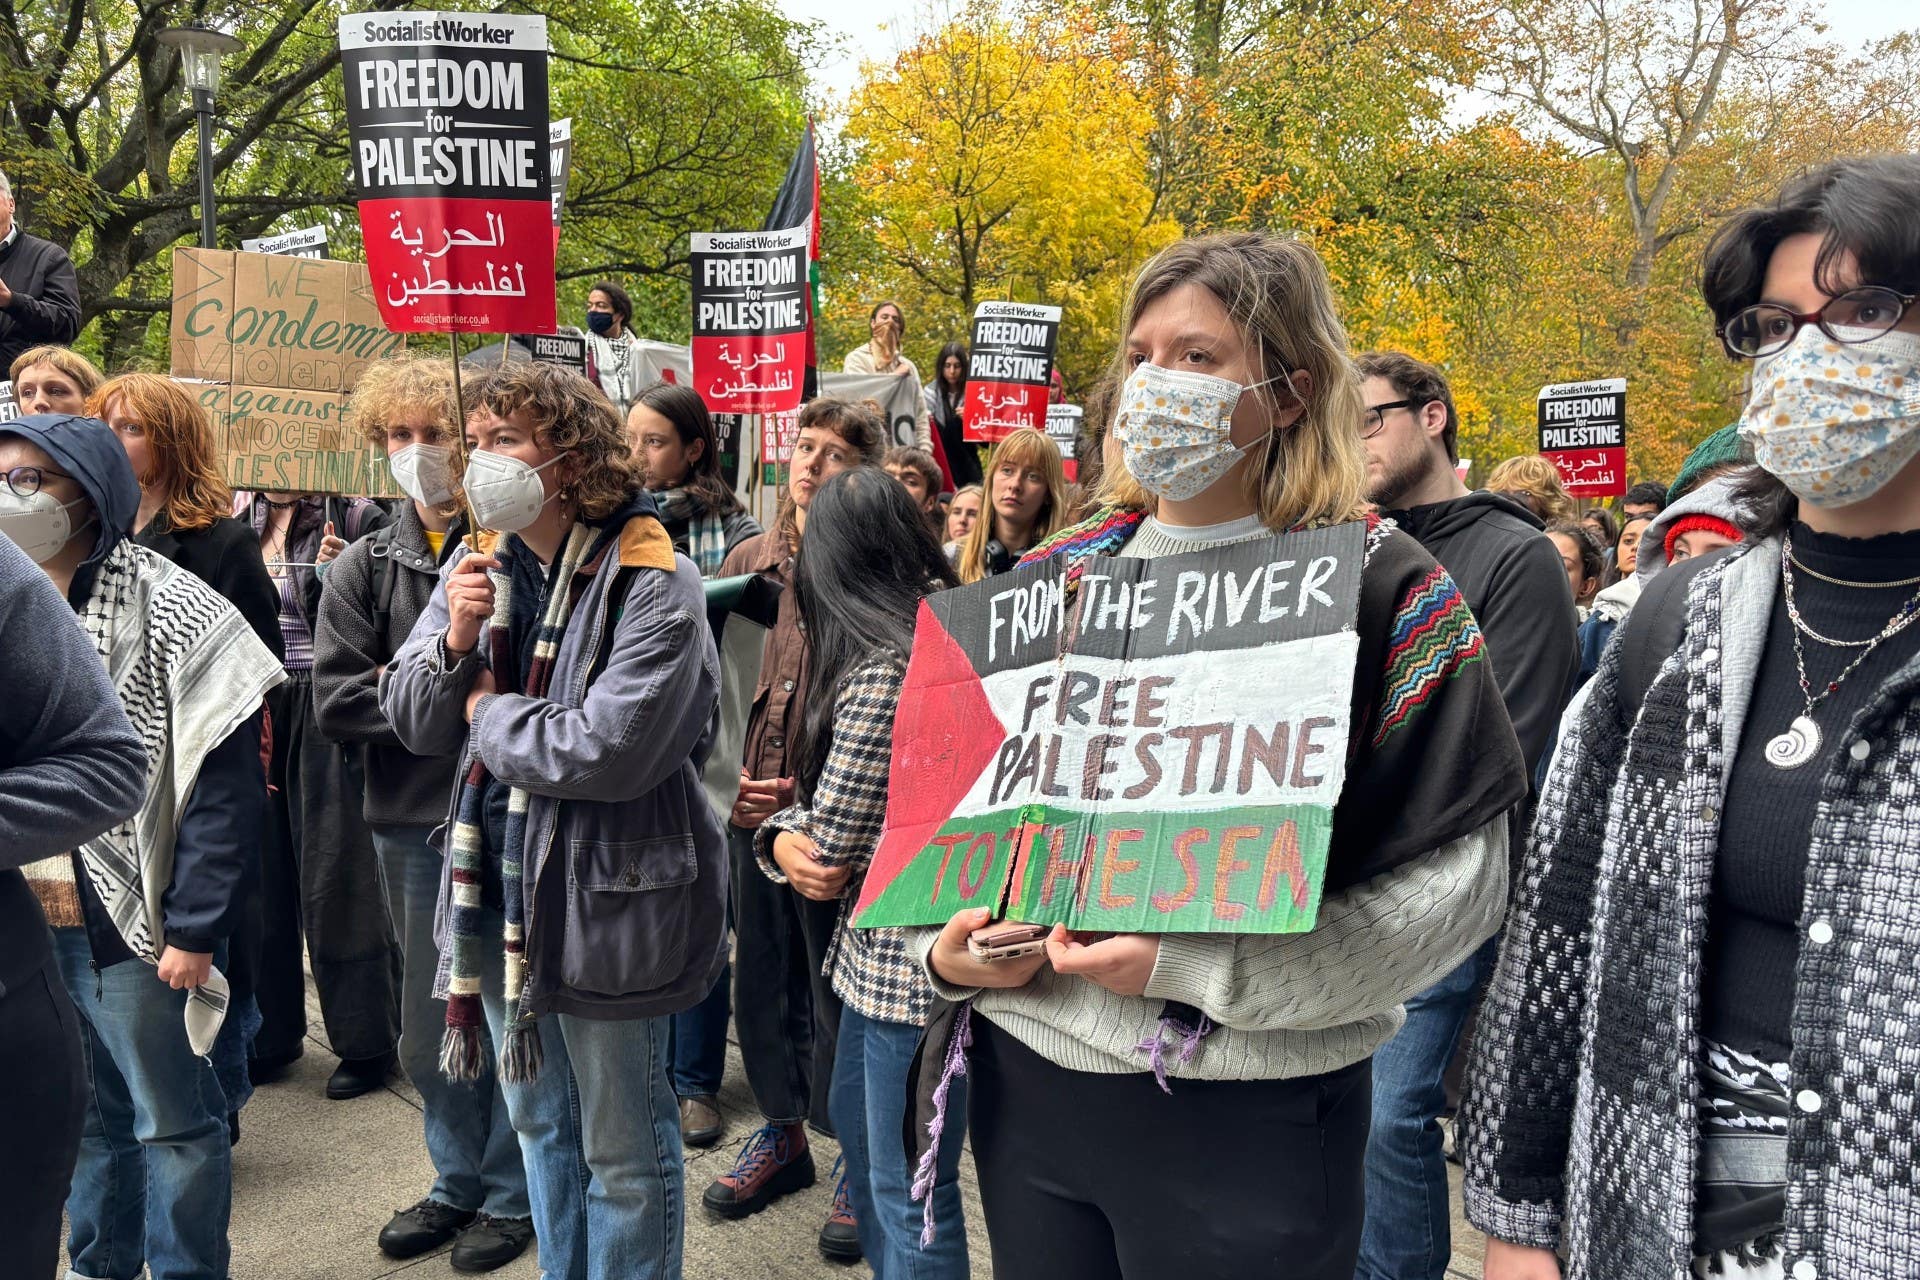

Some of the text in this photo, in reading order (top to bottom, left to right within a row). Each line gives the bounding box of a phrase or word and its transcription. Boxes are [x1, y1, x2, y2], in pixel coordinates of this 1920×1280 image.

[358, 59, 524, 110] FREEDOM
[425, 109, 453, 133] for
[359, 137, 537, 188] PALESTINE
[389, 210, 505, 257] الحرية
[265, 258, 325, 300] WE
[387, 259, 526, 307] لفلسطين
[703, 254, 796, 287] FREEDOM
[745, 286, 762, 300] for
[413, 312, 490, 325] socialistworker.co.uk
[699, 298, 801, 330] PALESTINE
[536, 337, 580, 358] FREEDOM
[976, 321, 1049, 347] FREEDOM
[718, 341, 785, 371] الحرية
[1001, 344, 1015, 356] for
[970, 355, 1048, 381] PALESTINE
[709, 369, 793, 398] لفلسطين
[977, 386, 1029, 409] الحرية
[1545, 396, 1616, 421] FREEDOM
[969, 408, 1034, 430] لفلسطين
[1574, 418, 1587, 427] for
[1543, 424, 1620, 448] PALESTINE
[1556, 452, 1607, 472] الحرية
[988, 556, 1339, 664] FROM THE RIVER
[1021, 670, 1176, 732] FREE
[988, 716, 1336, 807] PALESTINE
[929, 818, 1311, 921] TO THE SEA
